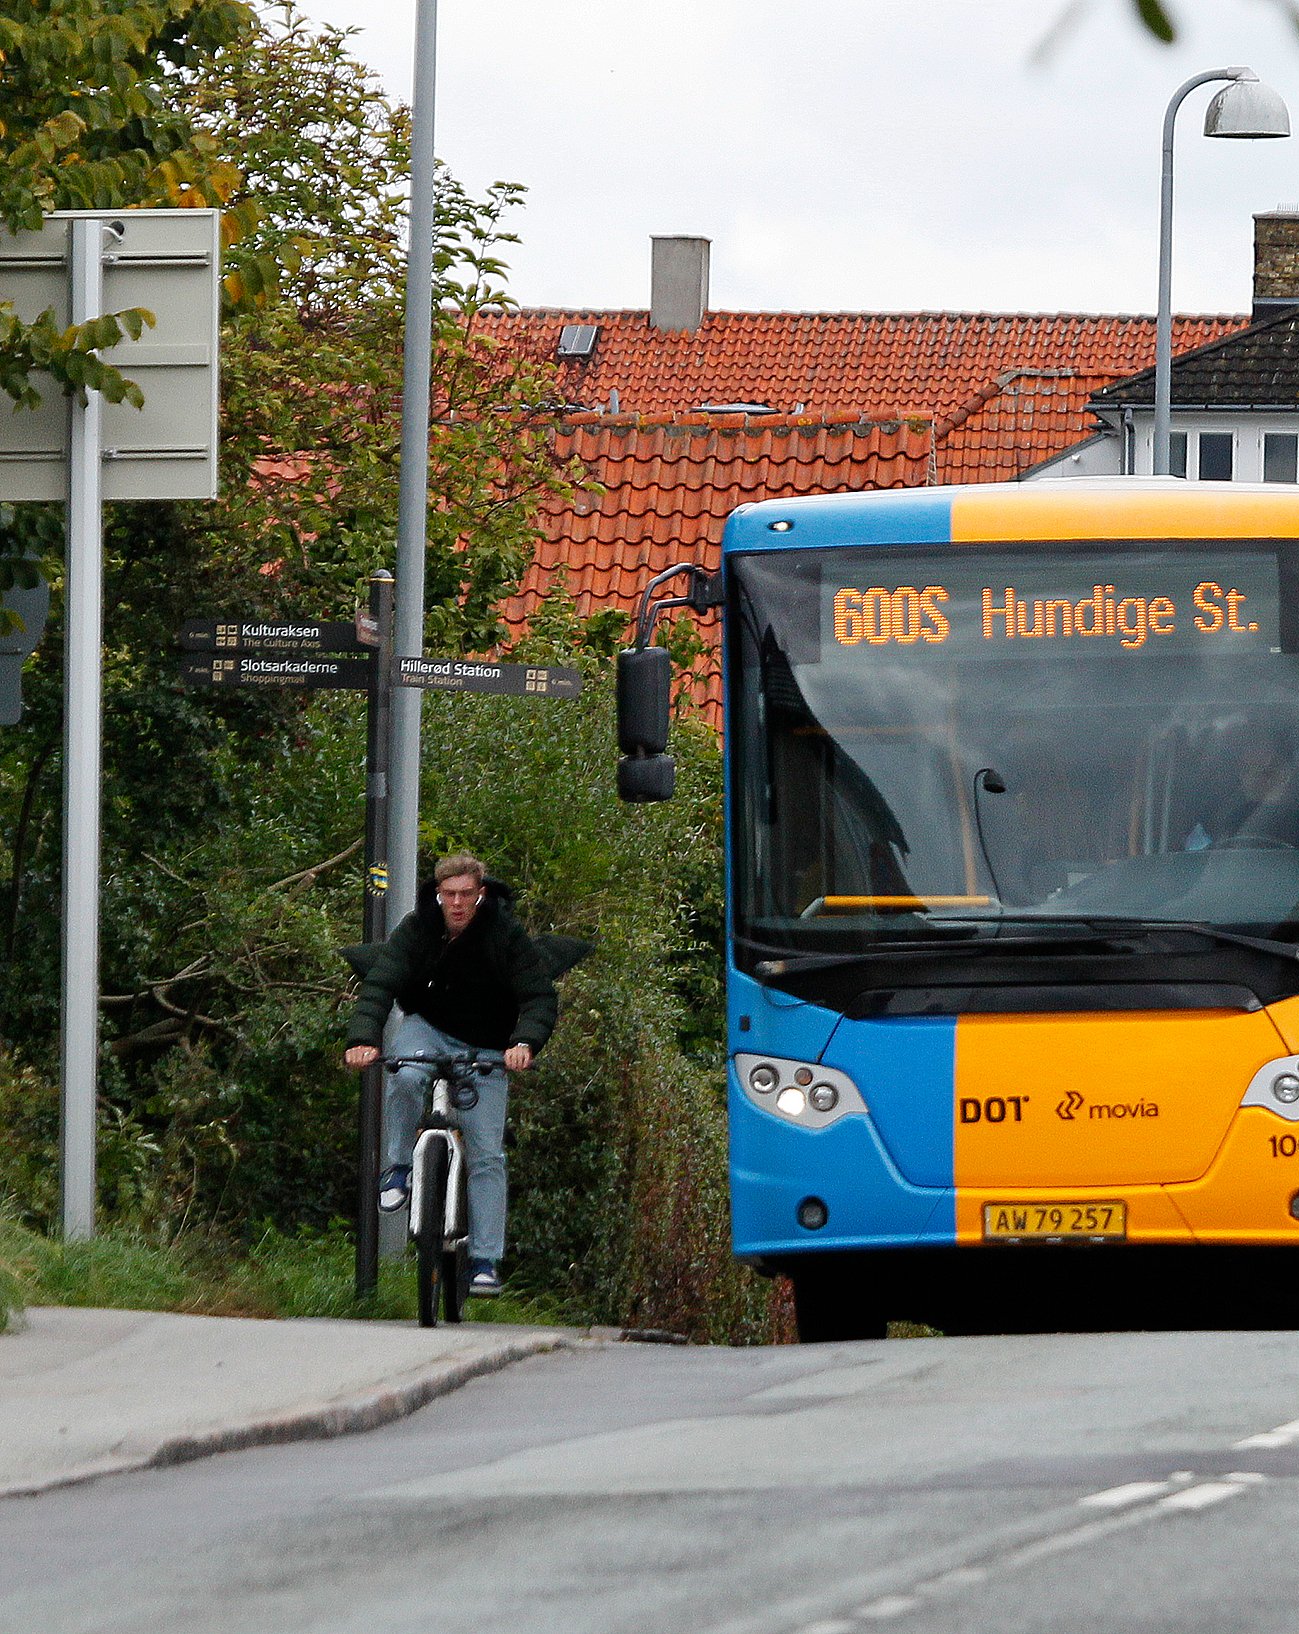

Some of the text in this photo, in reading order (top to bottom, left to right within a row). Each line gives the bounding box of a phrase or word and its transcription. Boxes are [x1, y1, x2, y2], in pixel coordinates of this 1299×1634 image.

[833, 581, 1259, 649] 600S Hundige St.
[241, 624, 319, 638] Kulturaksen
[243, 638, 321, 649] The Culture Axis
[240, 659, 338, 674] Slotsarkaderne
[400, 659, 500, 679] Hillerød Station
[240, 673, 305, 685] Shoppingmall
[401, 673, 464, 687] Train Station
[960, 1096, 1028, 1124] DOT
[1089, 1098, 1160, 1120] movia
[996, 1207, 1114, 1231] AW 79 257
